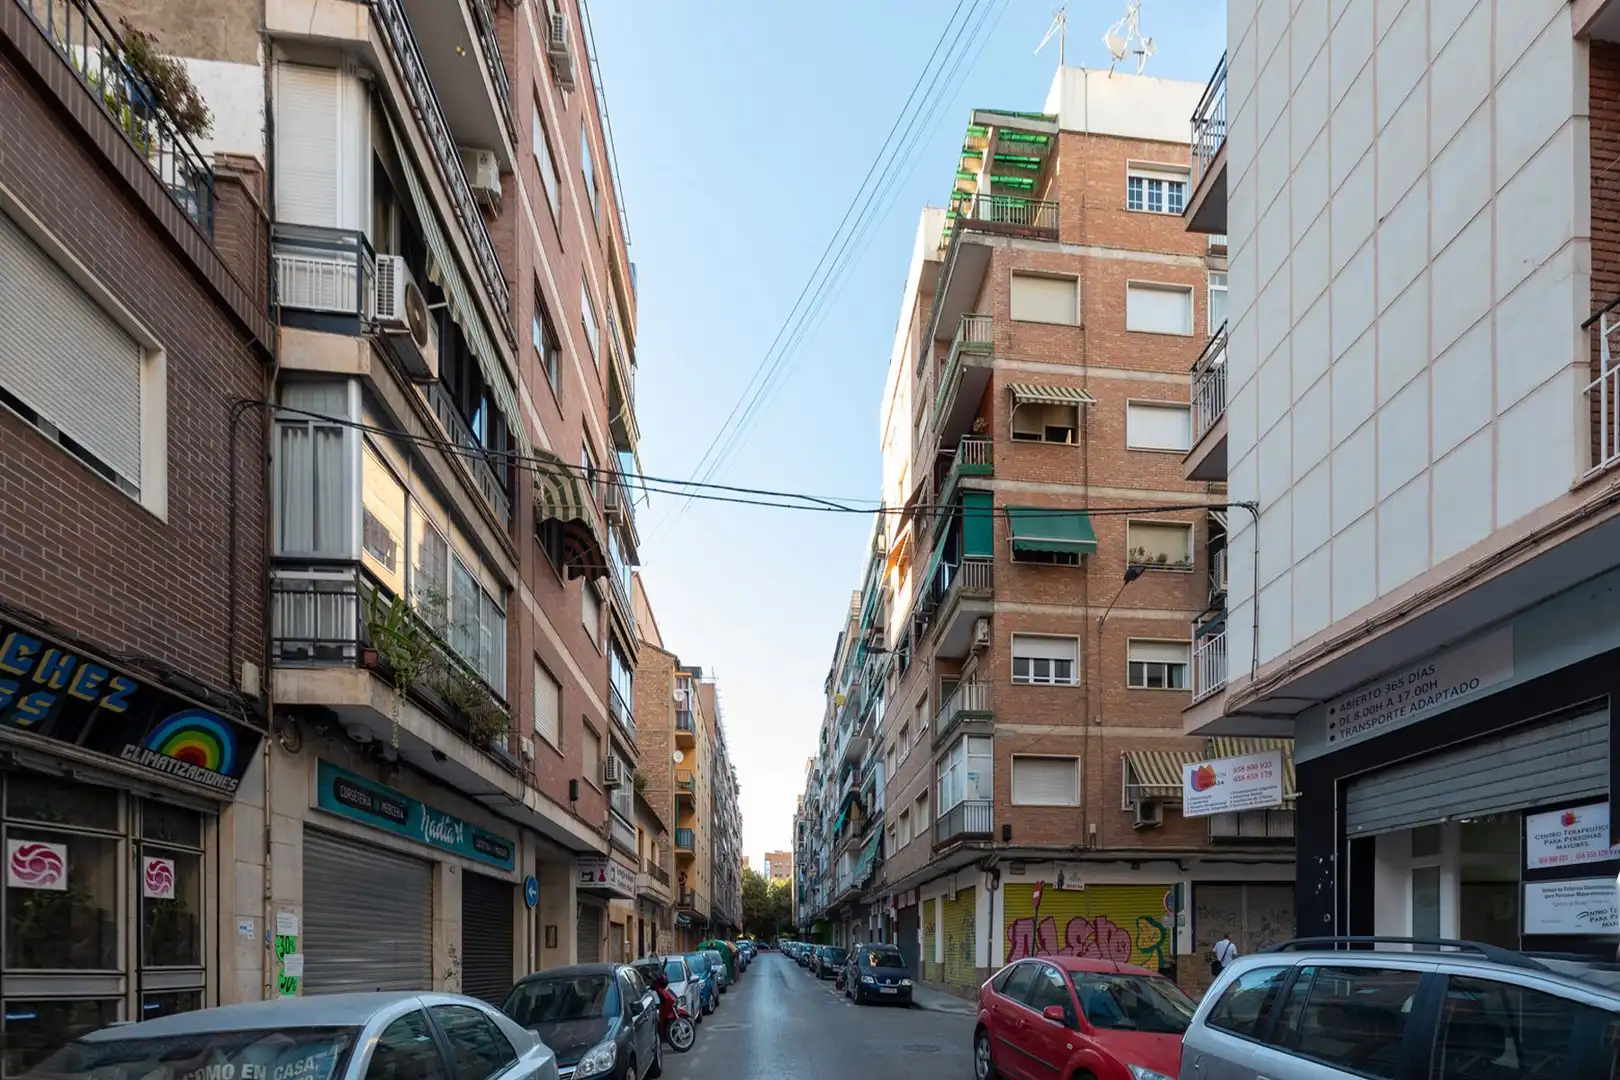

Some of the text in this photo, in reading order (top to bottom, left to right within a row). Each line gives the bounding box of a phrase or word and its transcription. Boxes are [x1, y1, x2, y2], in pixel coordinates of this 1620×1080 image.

[1339, 664, 1436, 713] ABIERTO 365 DÍAS
[1339, 679, 1438, 727] DE 8.00H A 17.00H
[1339, 677, 1480, 739] TRANSPORTE ADAPTADO
[120, 743, 239, 791] CLIMATIZACIONES
[1534, 831, 1562, 840] CENTRO
[1555, 841, 1589, 850] MAYORES
[1564, 833, 1602, 842] PERSONAS
[241, 1064, 266, 1080] EN
